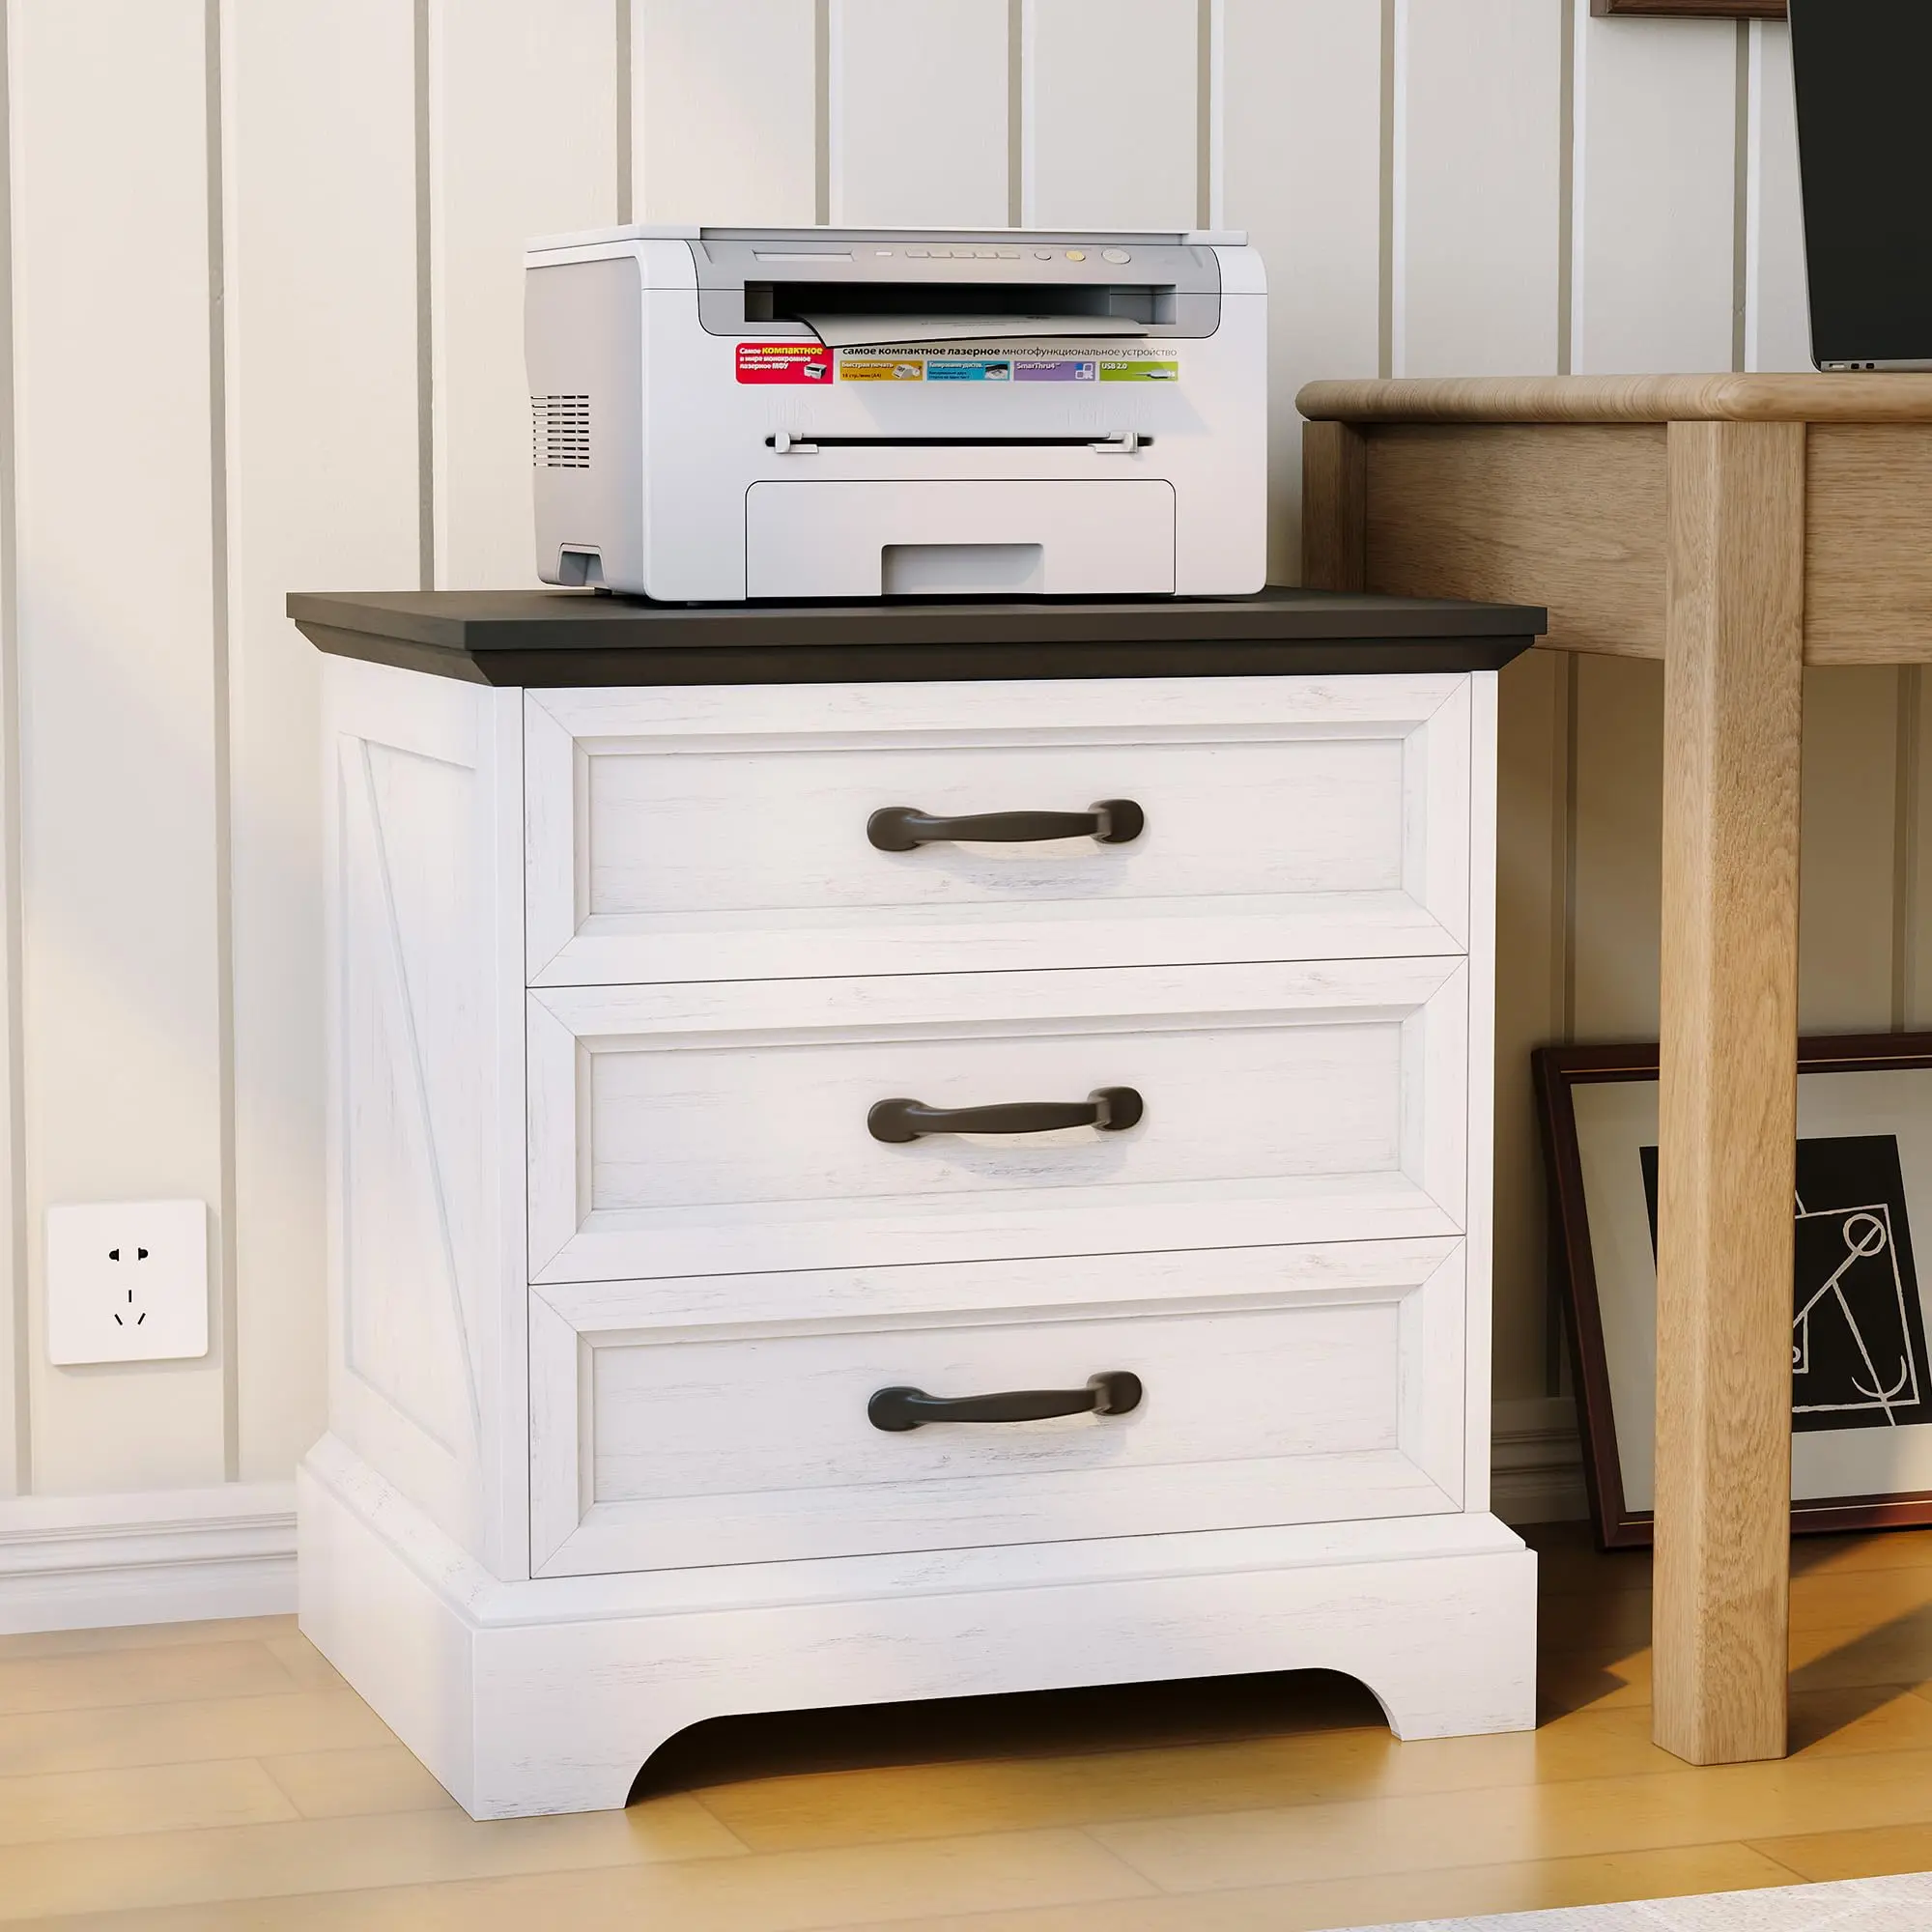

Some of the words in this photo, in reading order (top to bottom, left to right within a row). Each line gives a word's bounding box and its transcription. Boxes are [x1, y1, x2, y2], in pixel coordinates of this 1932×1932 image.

[947, 348, 1000, 357] лазерное
[1002, 347, 1121, 357] многофункциональное
[1122, 348, 1177, 357] устройство
